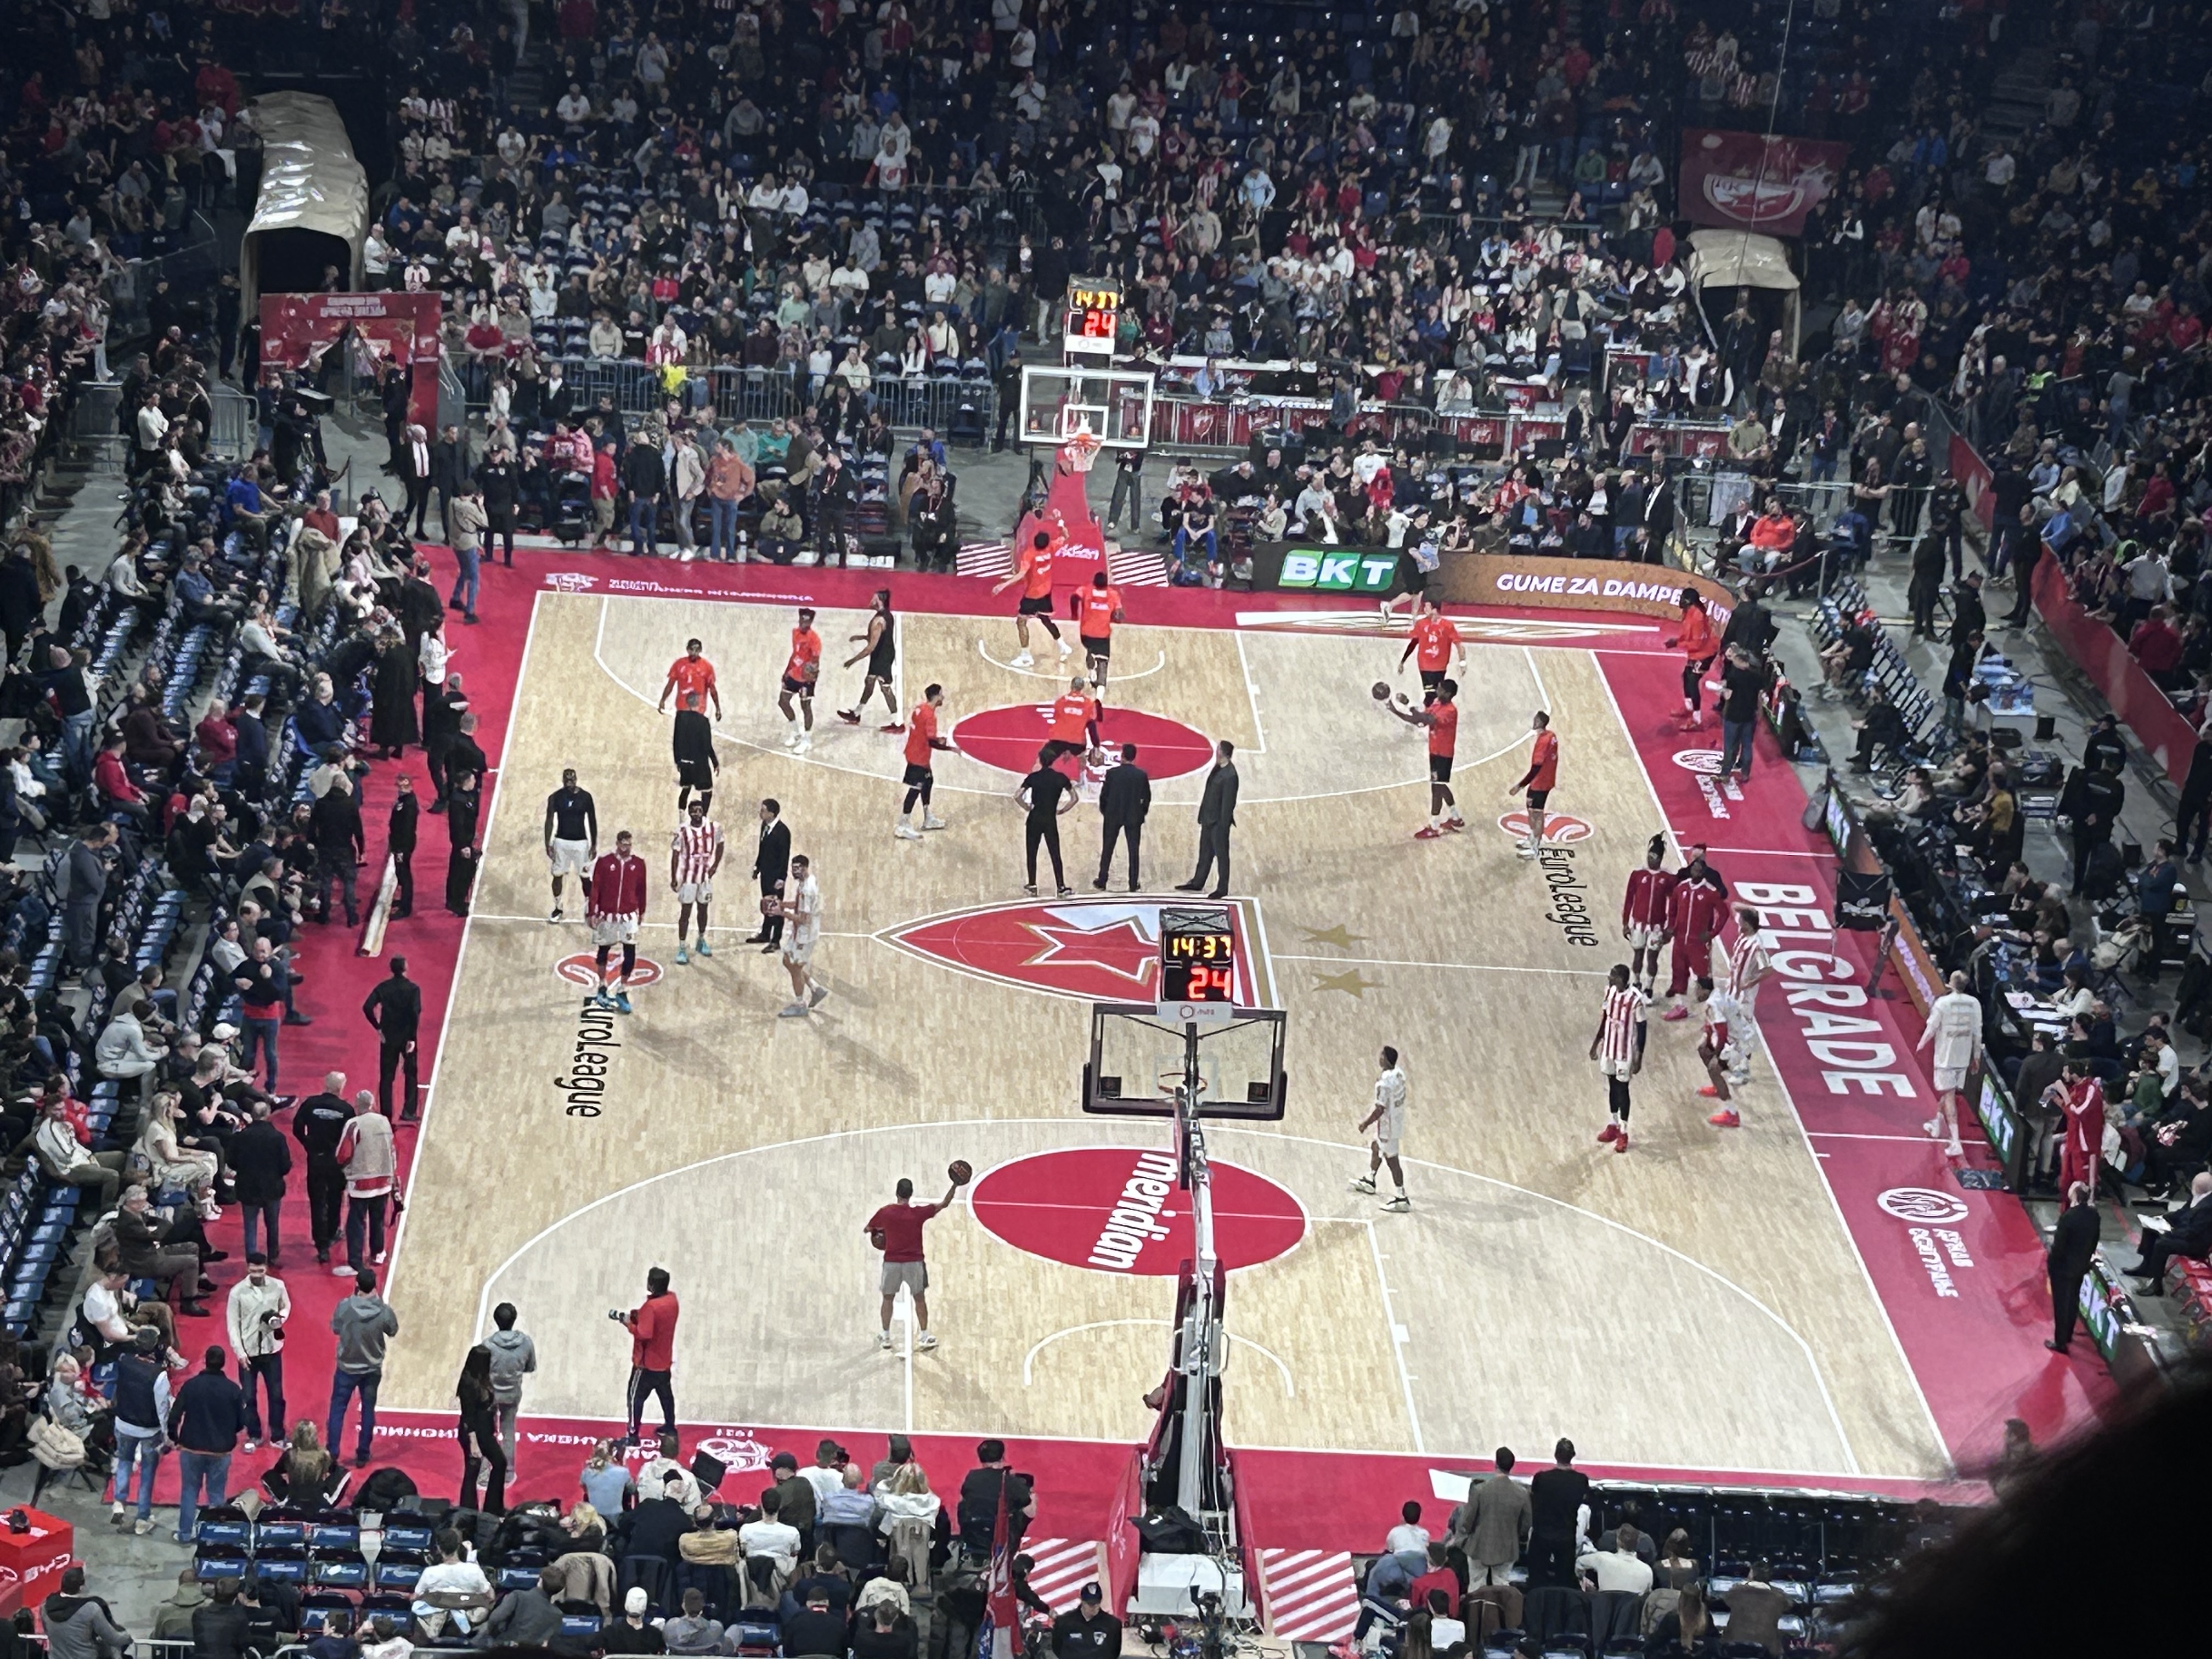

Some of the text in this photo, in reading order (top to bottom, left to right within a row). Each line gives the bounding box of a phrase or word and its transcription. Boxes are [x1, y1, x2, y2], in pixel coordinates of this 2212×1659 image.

[1085, 311, 1116, 338] 24
[1283, 555, 1393, 585] BKT
[1497, 573, 1566, 593] GUME
[1567, 578, 1599, 595] ZA
[1602, 579, 1707, 606] DAMPE
[1538, 848, 1599, 946] EuroLeague
[1172, 935, 1231, 958] 14:37
[1188, 967, 1231, 999] 24
[1733, 882, 1918, 1098] BELGRADE
[1087, 1153, 1178, 1269] meridian
